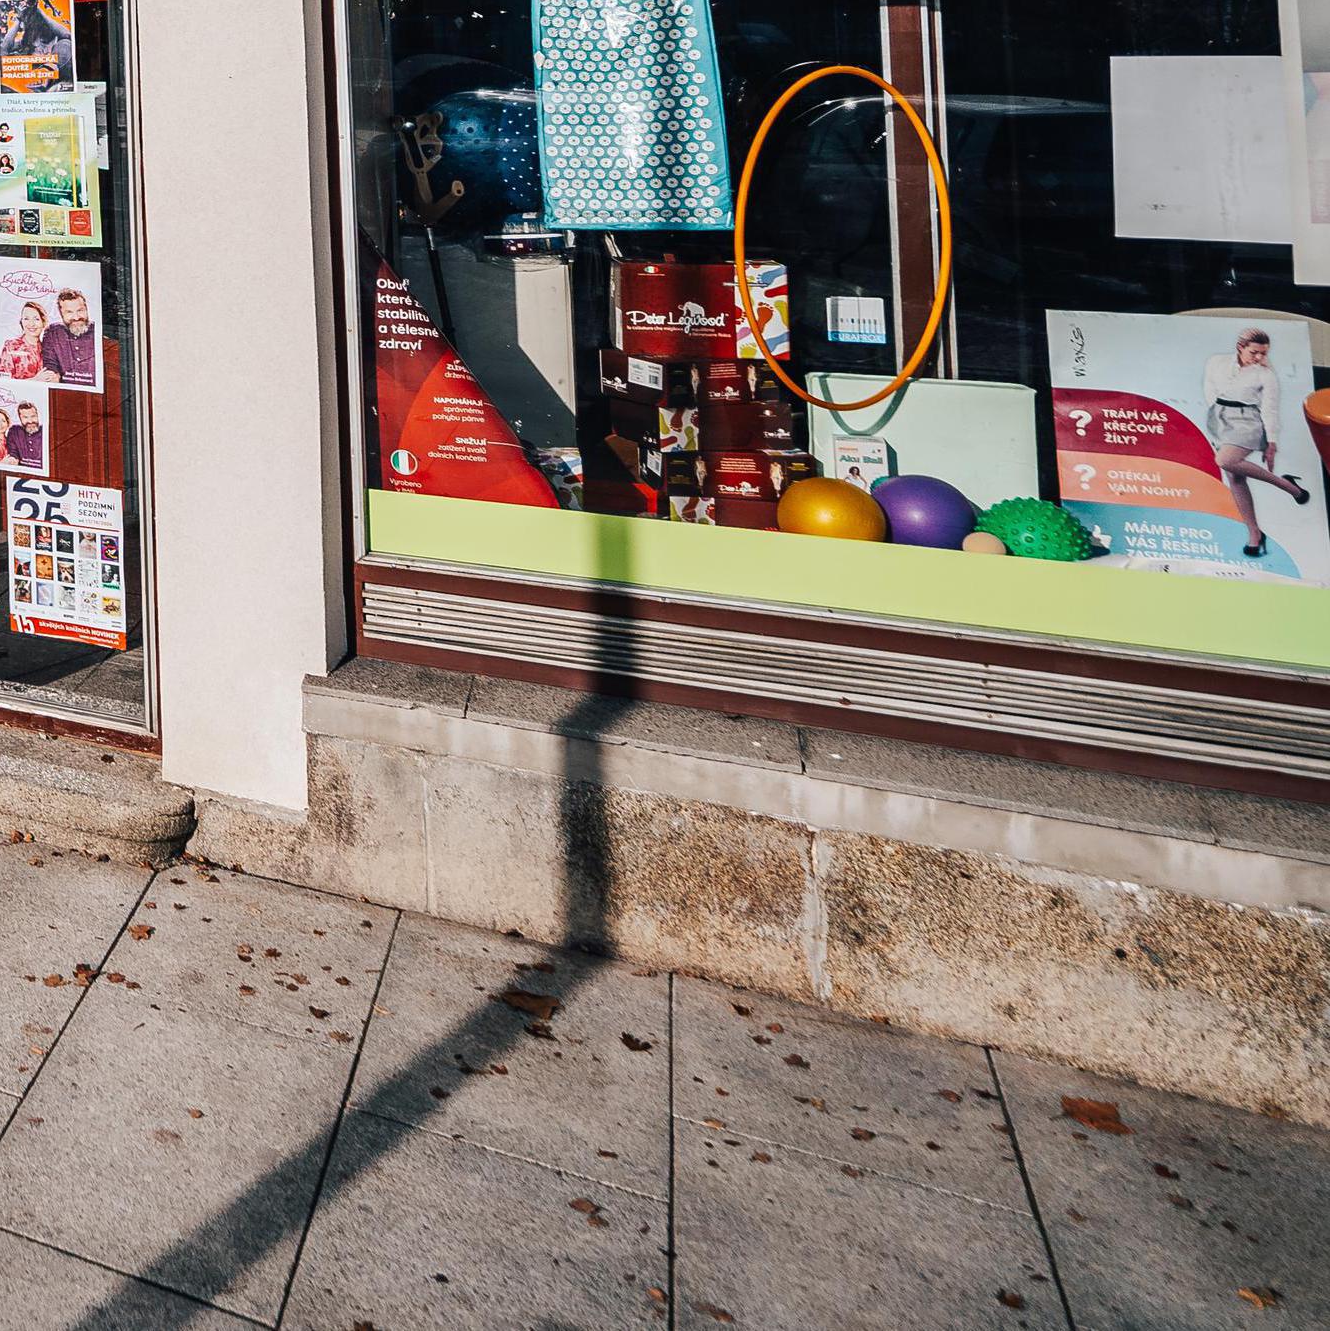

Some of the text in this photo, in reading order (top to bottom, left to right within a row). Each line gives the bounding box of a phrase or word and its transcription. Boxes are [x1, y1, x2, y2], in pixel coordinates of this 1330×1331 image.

[0, 272, 37, 288] Buchty
[377, 292, 413, 306] které
[377, 309, 430, 323] stabilitu
[626, 310, 666, 326] Peter
[667, 311, 726, 334] Legwood
[378, 323, 440, 338] a tělesné
[832, 333, 881, 342] CURAPROX
[378, 338, 423, 351] zdraví
[433, 397, 483, 407] NAPOMÁHAJÍ
[443, 406, 484, 415] správnému
[1101, 408, 1168, 422] TRÁPÍ VÁS
[432, 413, 461, 422] pohybu
[1102, 420, 1165, 435] KŘEČOVÉ
[455, 436, 487, 445] SNIŽUJÍ
[1104, 432, 1138, 445] ŽÍLY?
[427, 450, 487, 462] dolních končetin
[839, 454, 860, 463] Aku
[1106, 468, 1162, 483] OTÉKAJÍ
[389, 477, 422, 489] Vyrobeno
[1107, 481, 1191, 498] VÁM NOHY?
[78, 490, 101, 500] HITY
[78, 500, 115, 511] PODZIMNÍ
[1124, 520, 1213, 541] MÁME PRO
[1124, 535, 1158, 549] VÁS
[12, 613, 36, 635] 15
